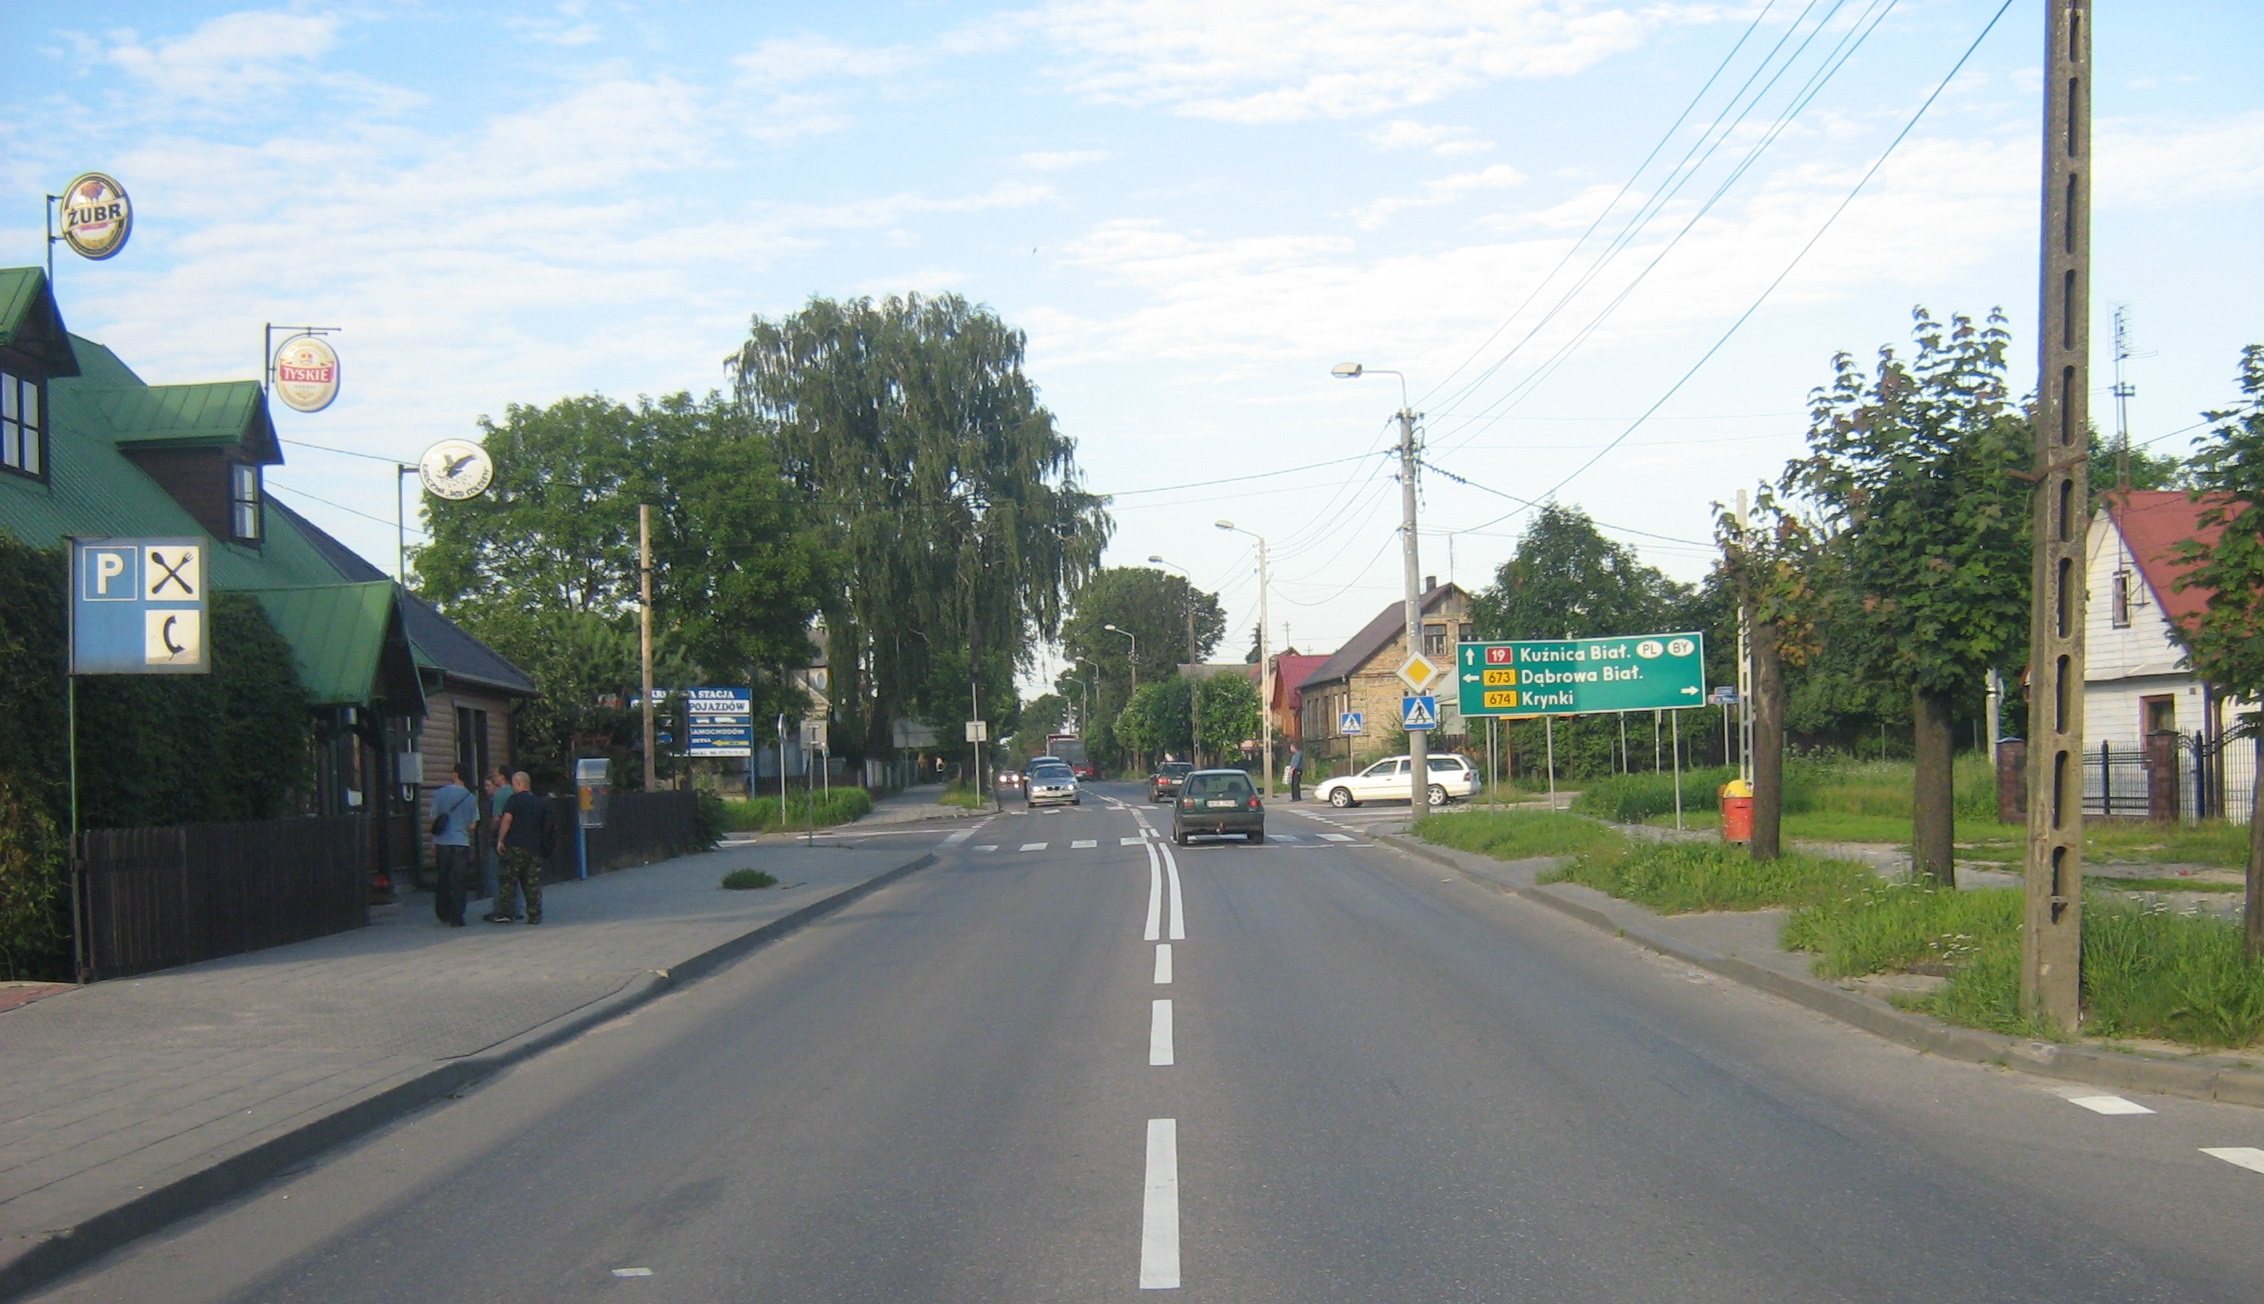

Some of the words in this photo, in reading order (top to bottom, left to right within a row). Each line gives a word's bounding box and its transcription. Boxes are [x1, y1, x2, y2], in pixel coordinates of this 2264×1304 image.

[69, 203, 121, 226] ŻUBR
[283, 366, 330, 382] TYSKIE
[97, 553, 123, 594] P
[1520, 646, 1586, 662] Kuźnica
[1590, 644, 1631, 660] Biał.
[1642, 644, 1657, 655] PL
[1673, 642, 1688, 653] BY
[1491, 649, 1506, 662] 19
[1488, 671, 1511, 683] 673
[1521, 669, 1598, 687] Dąbrowa
[1603, 664, 1644, 681] Biał.
[698, 690, 735, 699] STACJA
[1489, 693, 1511, 705] 674
[1522, 690, 1574, 709] Krynki
[690, 701, 745, 711] POJAZDÓW
